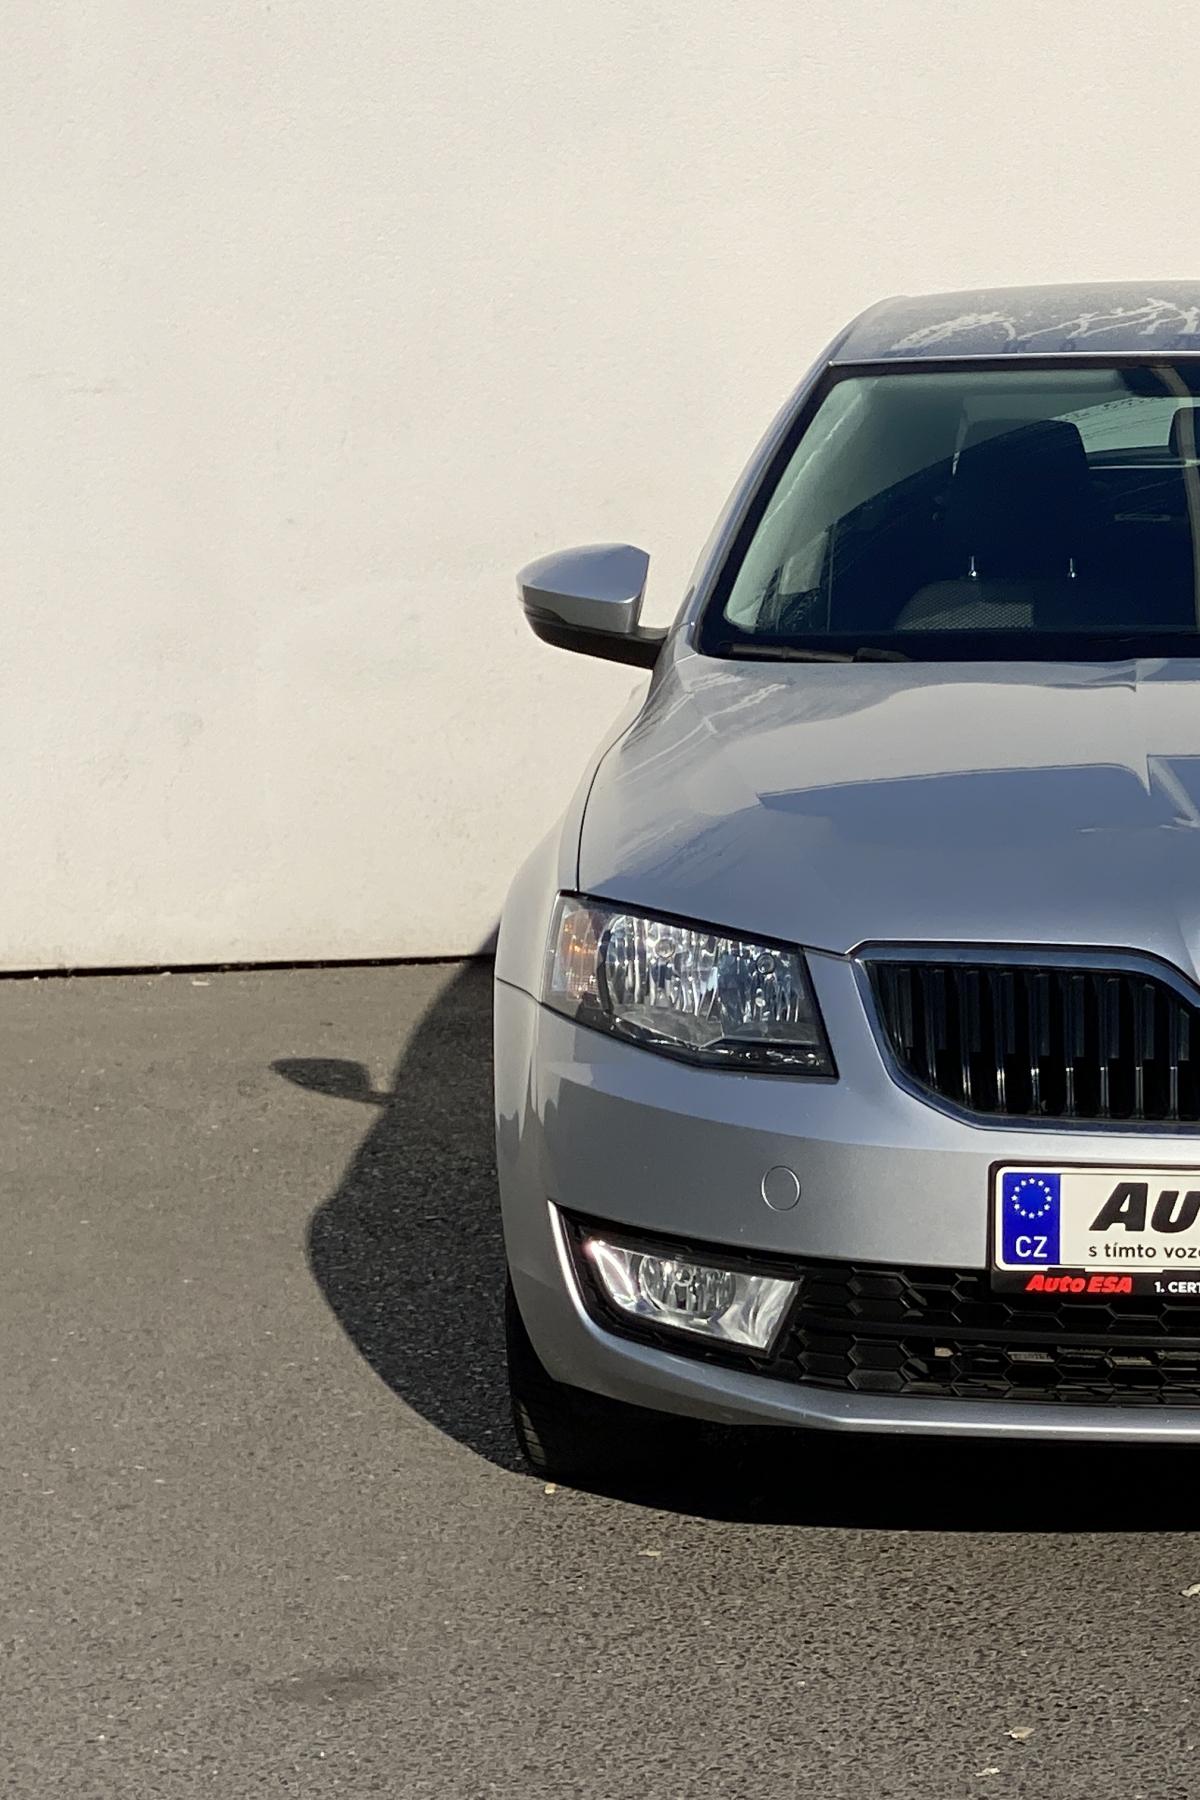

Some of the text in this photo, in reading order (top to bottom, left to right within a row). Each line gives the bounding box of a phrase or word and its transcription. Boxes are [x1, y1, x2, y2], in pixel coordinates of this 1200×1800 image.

[1015, 1235, 1048, 1258] CZ
[1088, 1245, 1098, 1258] s
[1104, 1242, 1157, 1258] tímto
[1025, 1274, 1133, 1294] Auto ESA
[1154, 1281, 1166, 1293] 1.
